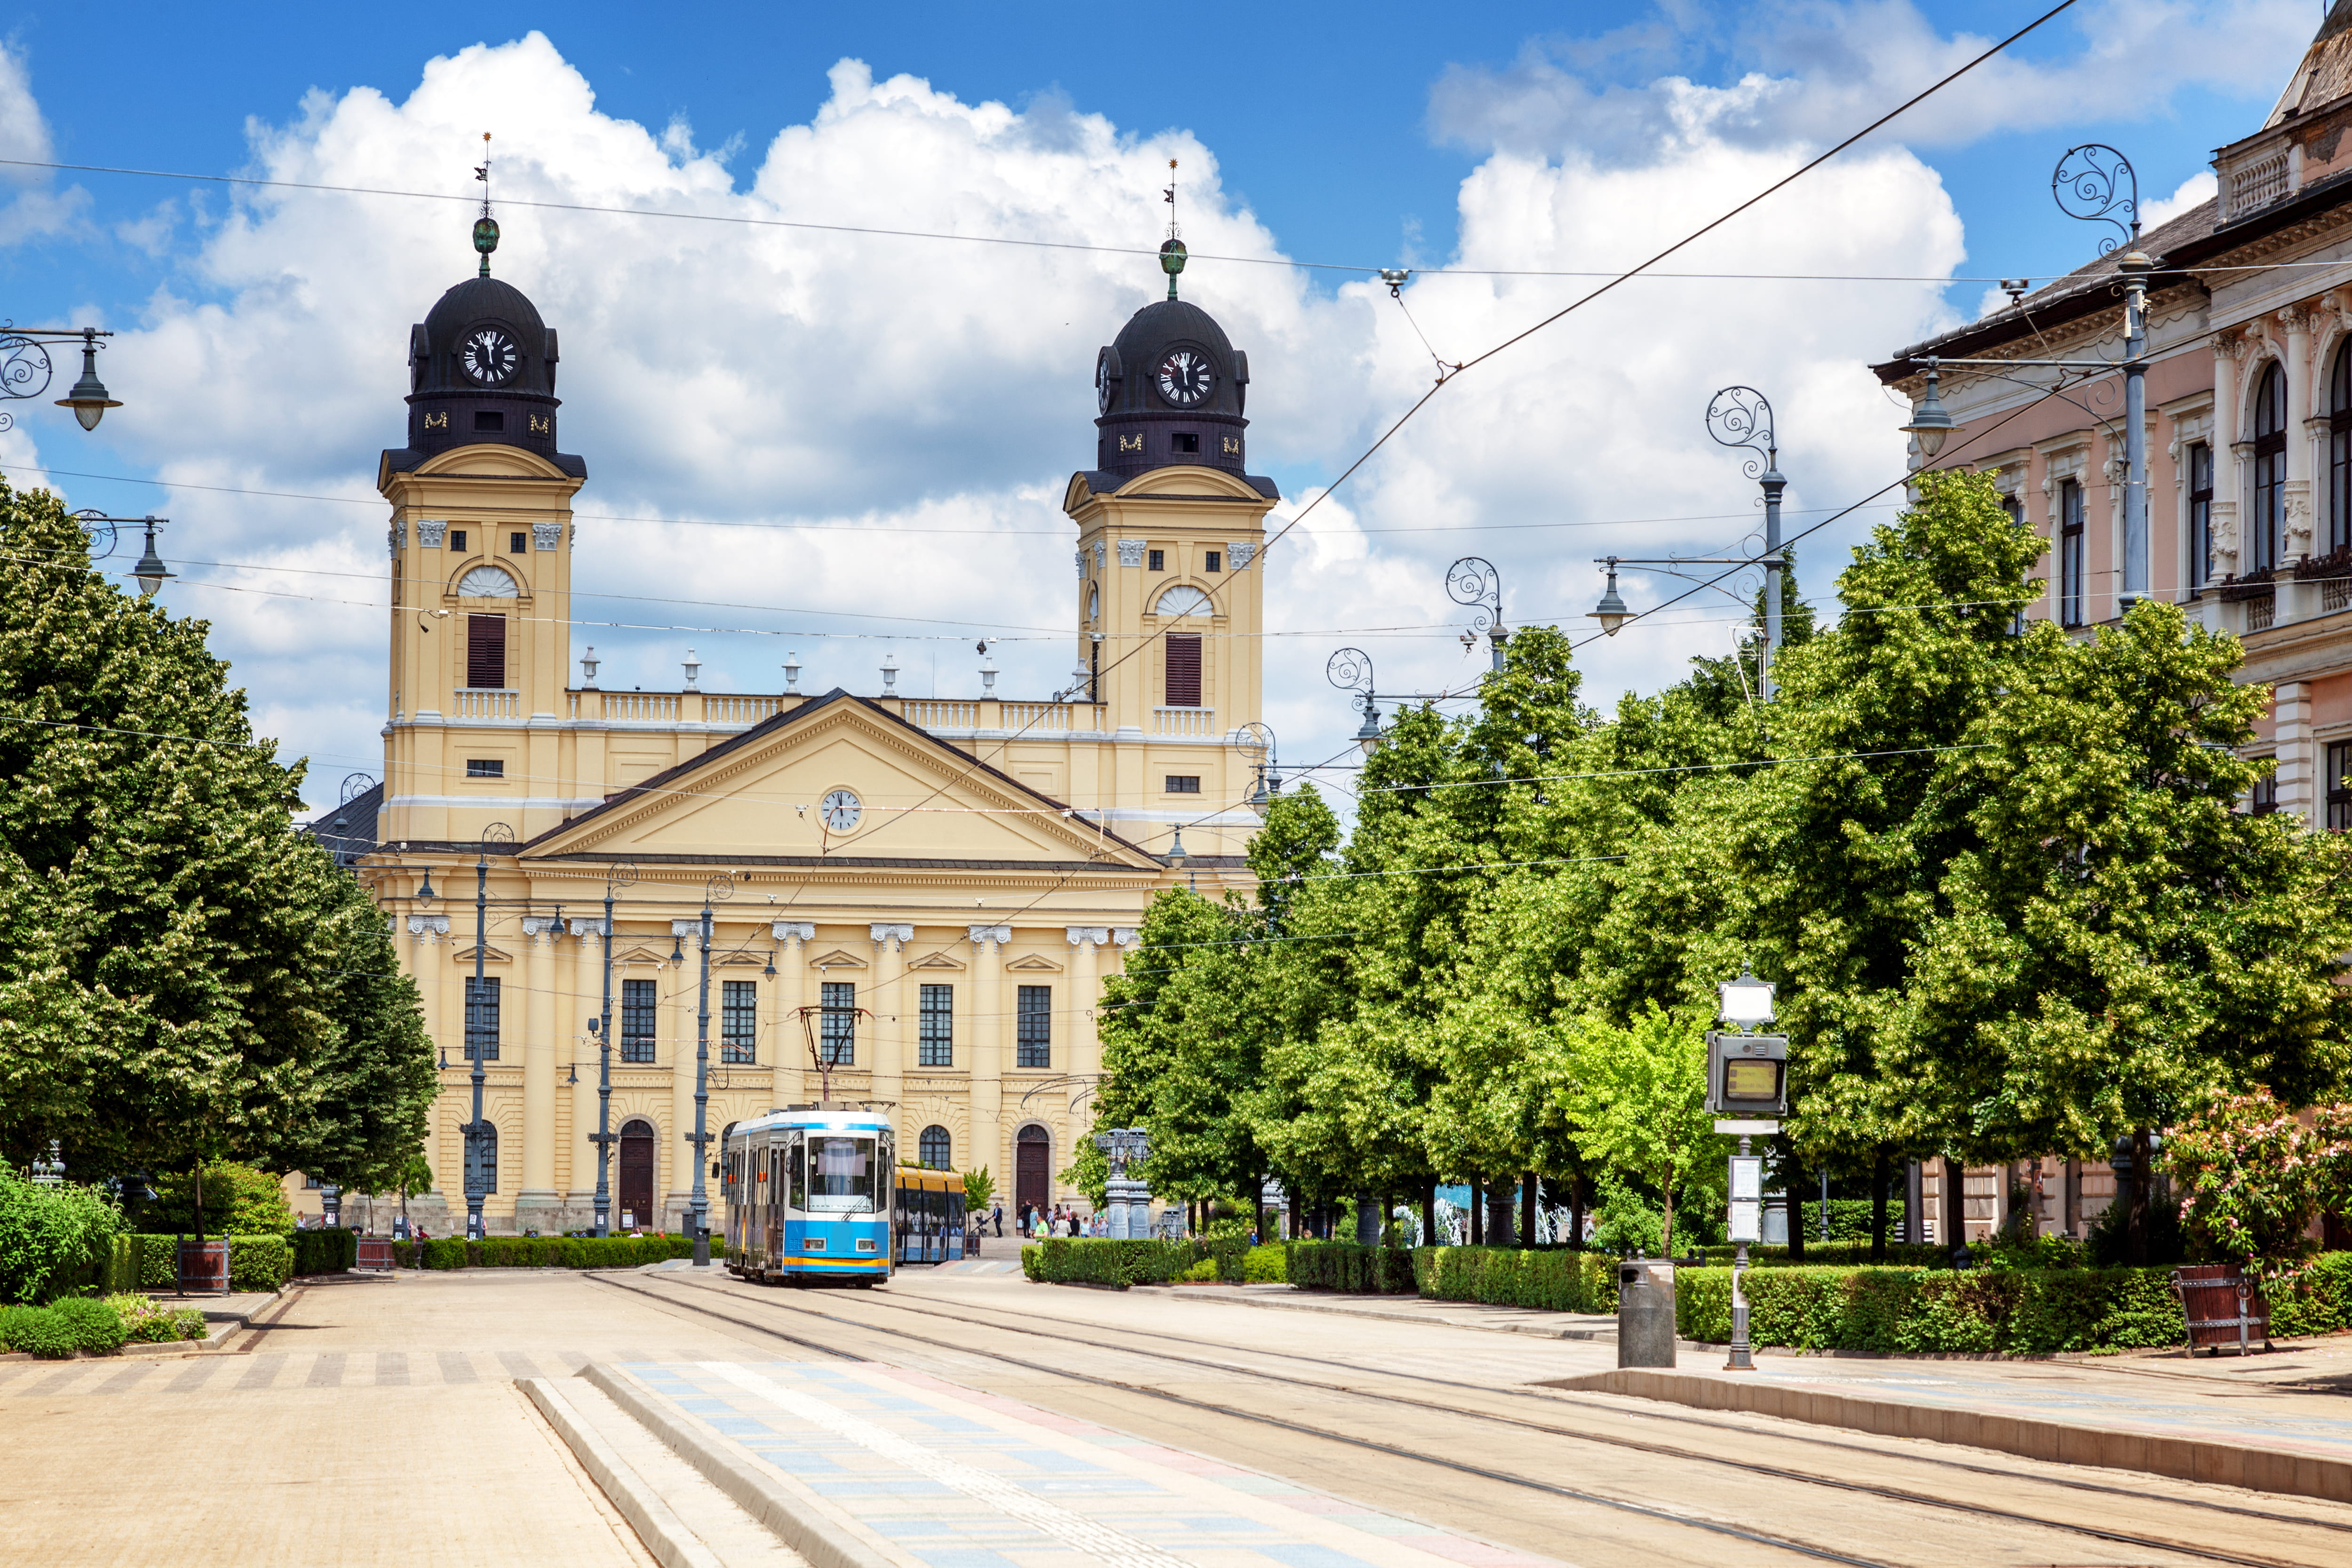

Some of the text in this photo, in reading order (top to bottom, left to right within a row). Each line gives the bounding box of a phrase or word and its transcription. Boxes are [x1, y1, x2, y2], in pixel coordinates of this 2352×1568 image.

[467, 340, 479, 350] X
[465, 359, 478, 372] VIII
[502, 362, 513, 373] IV
[1162, 363, 1174, 372] X
[473, 366, 484, 379] VII
[487, 370, 494, 382] VI
[496, 369, 504, 380] V
[1161, 381, 1174, 394] VIII
[1197, 382, 1208, 393] IV
[1169, 388, 1180, 401] VII
[1183, 391, 1190, 403] VI
[1192, 390, 1200, 400] V
